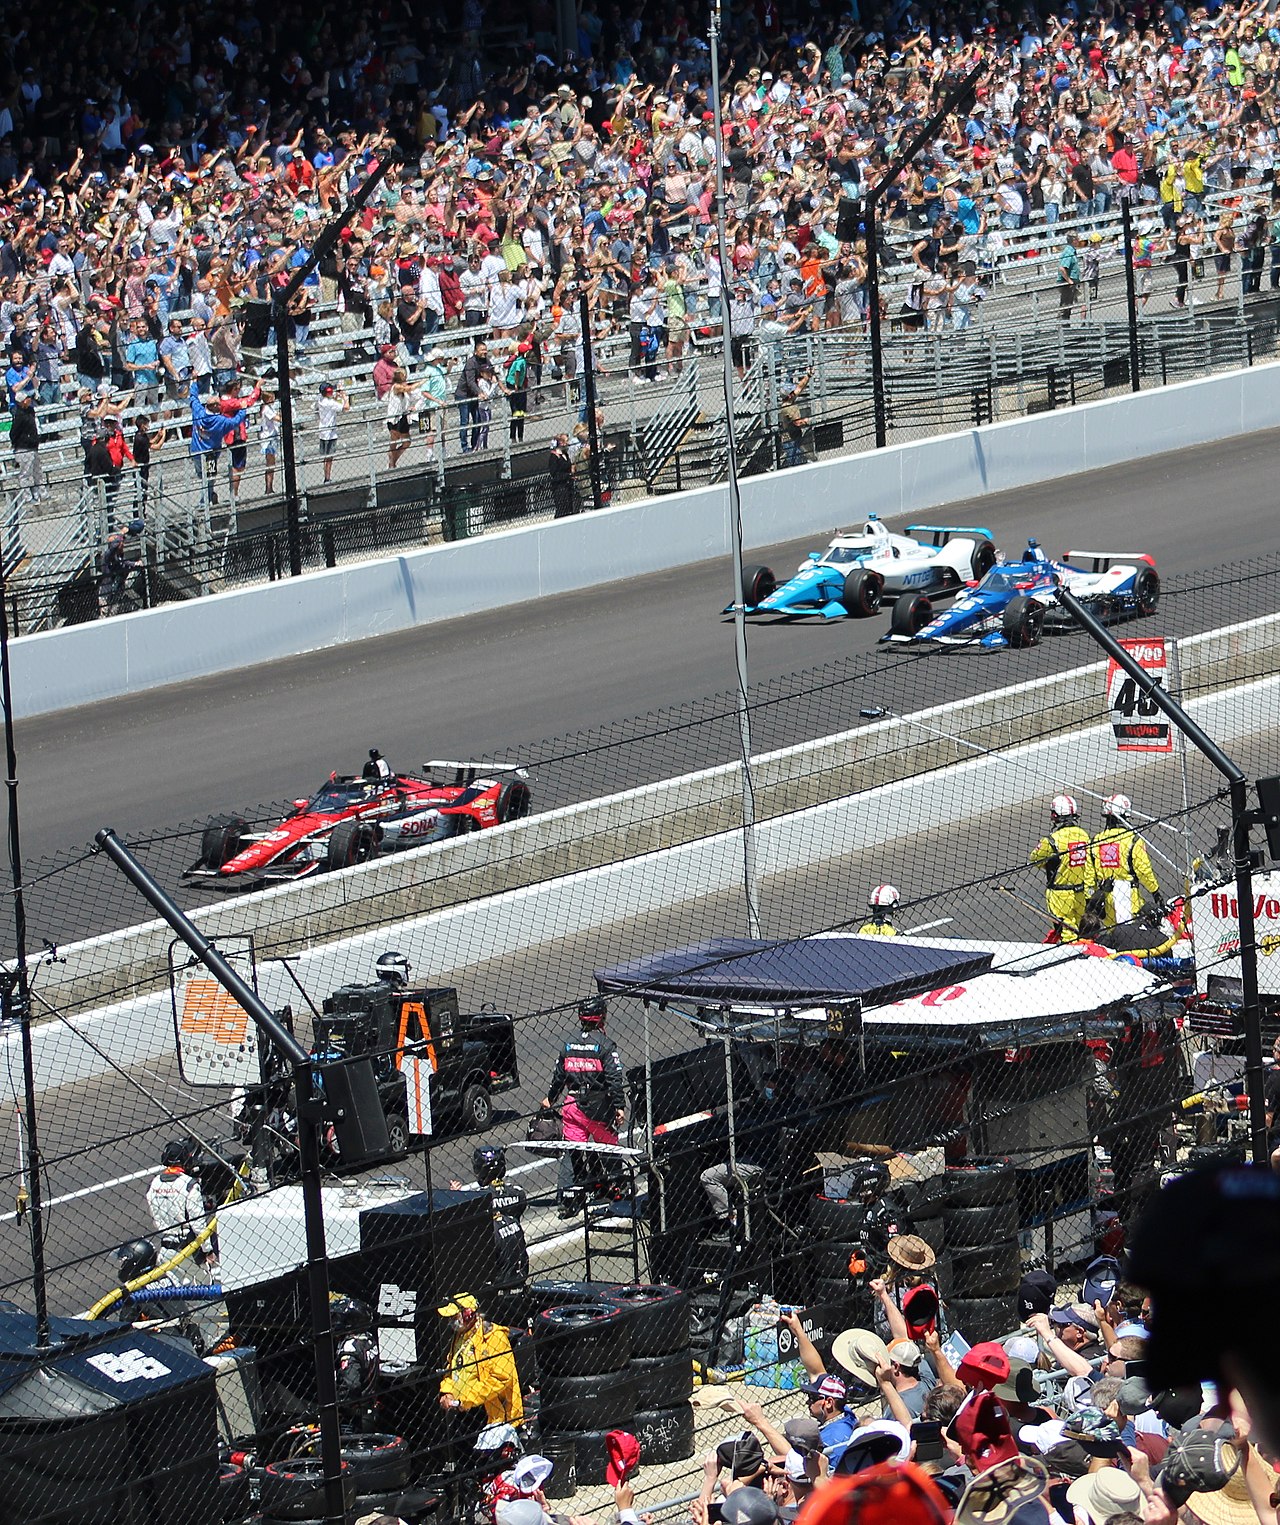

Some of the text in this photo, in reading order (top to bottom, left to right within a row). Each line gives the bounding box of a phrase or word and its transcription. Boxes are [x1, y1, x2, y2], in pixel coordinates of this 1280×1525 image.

[401, 817, 437, 836] SONAX
[803, 1318, 813, 1333] NO
[793, 1327, 824, 1349] SKING
